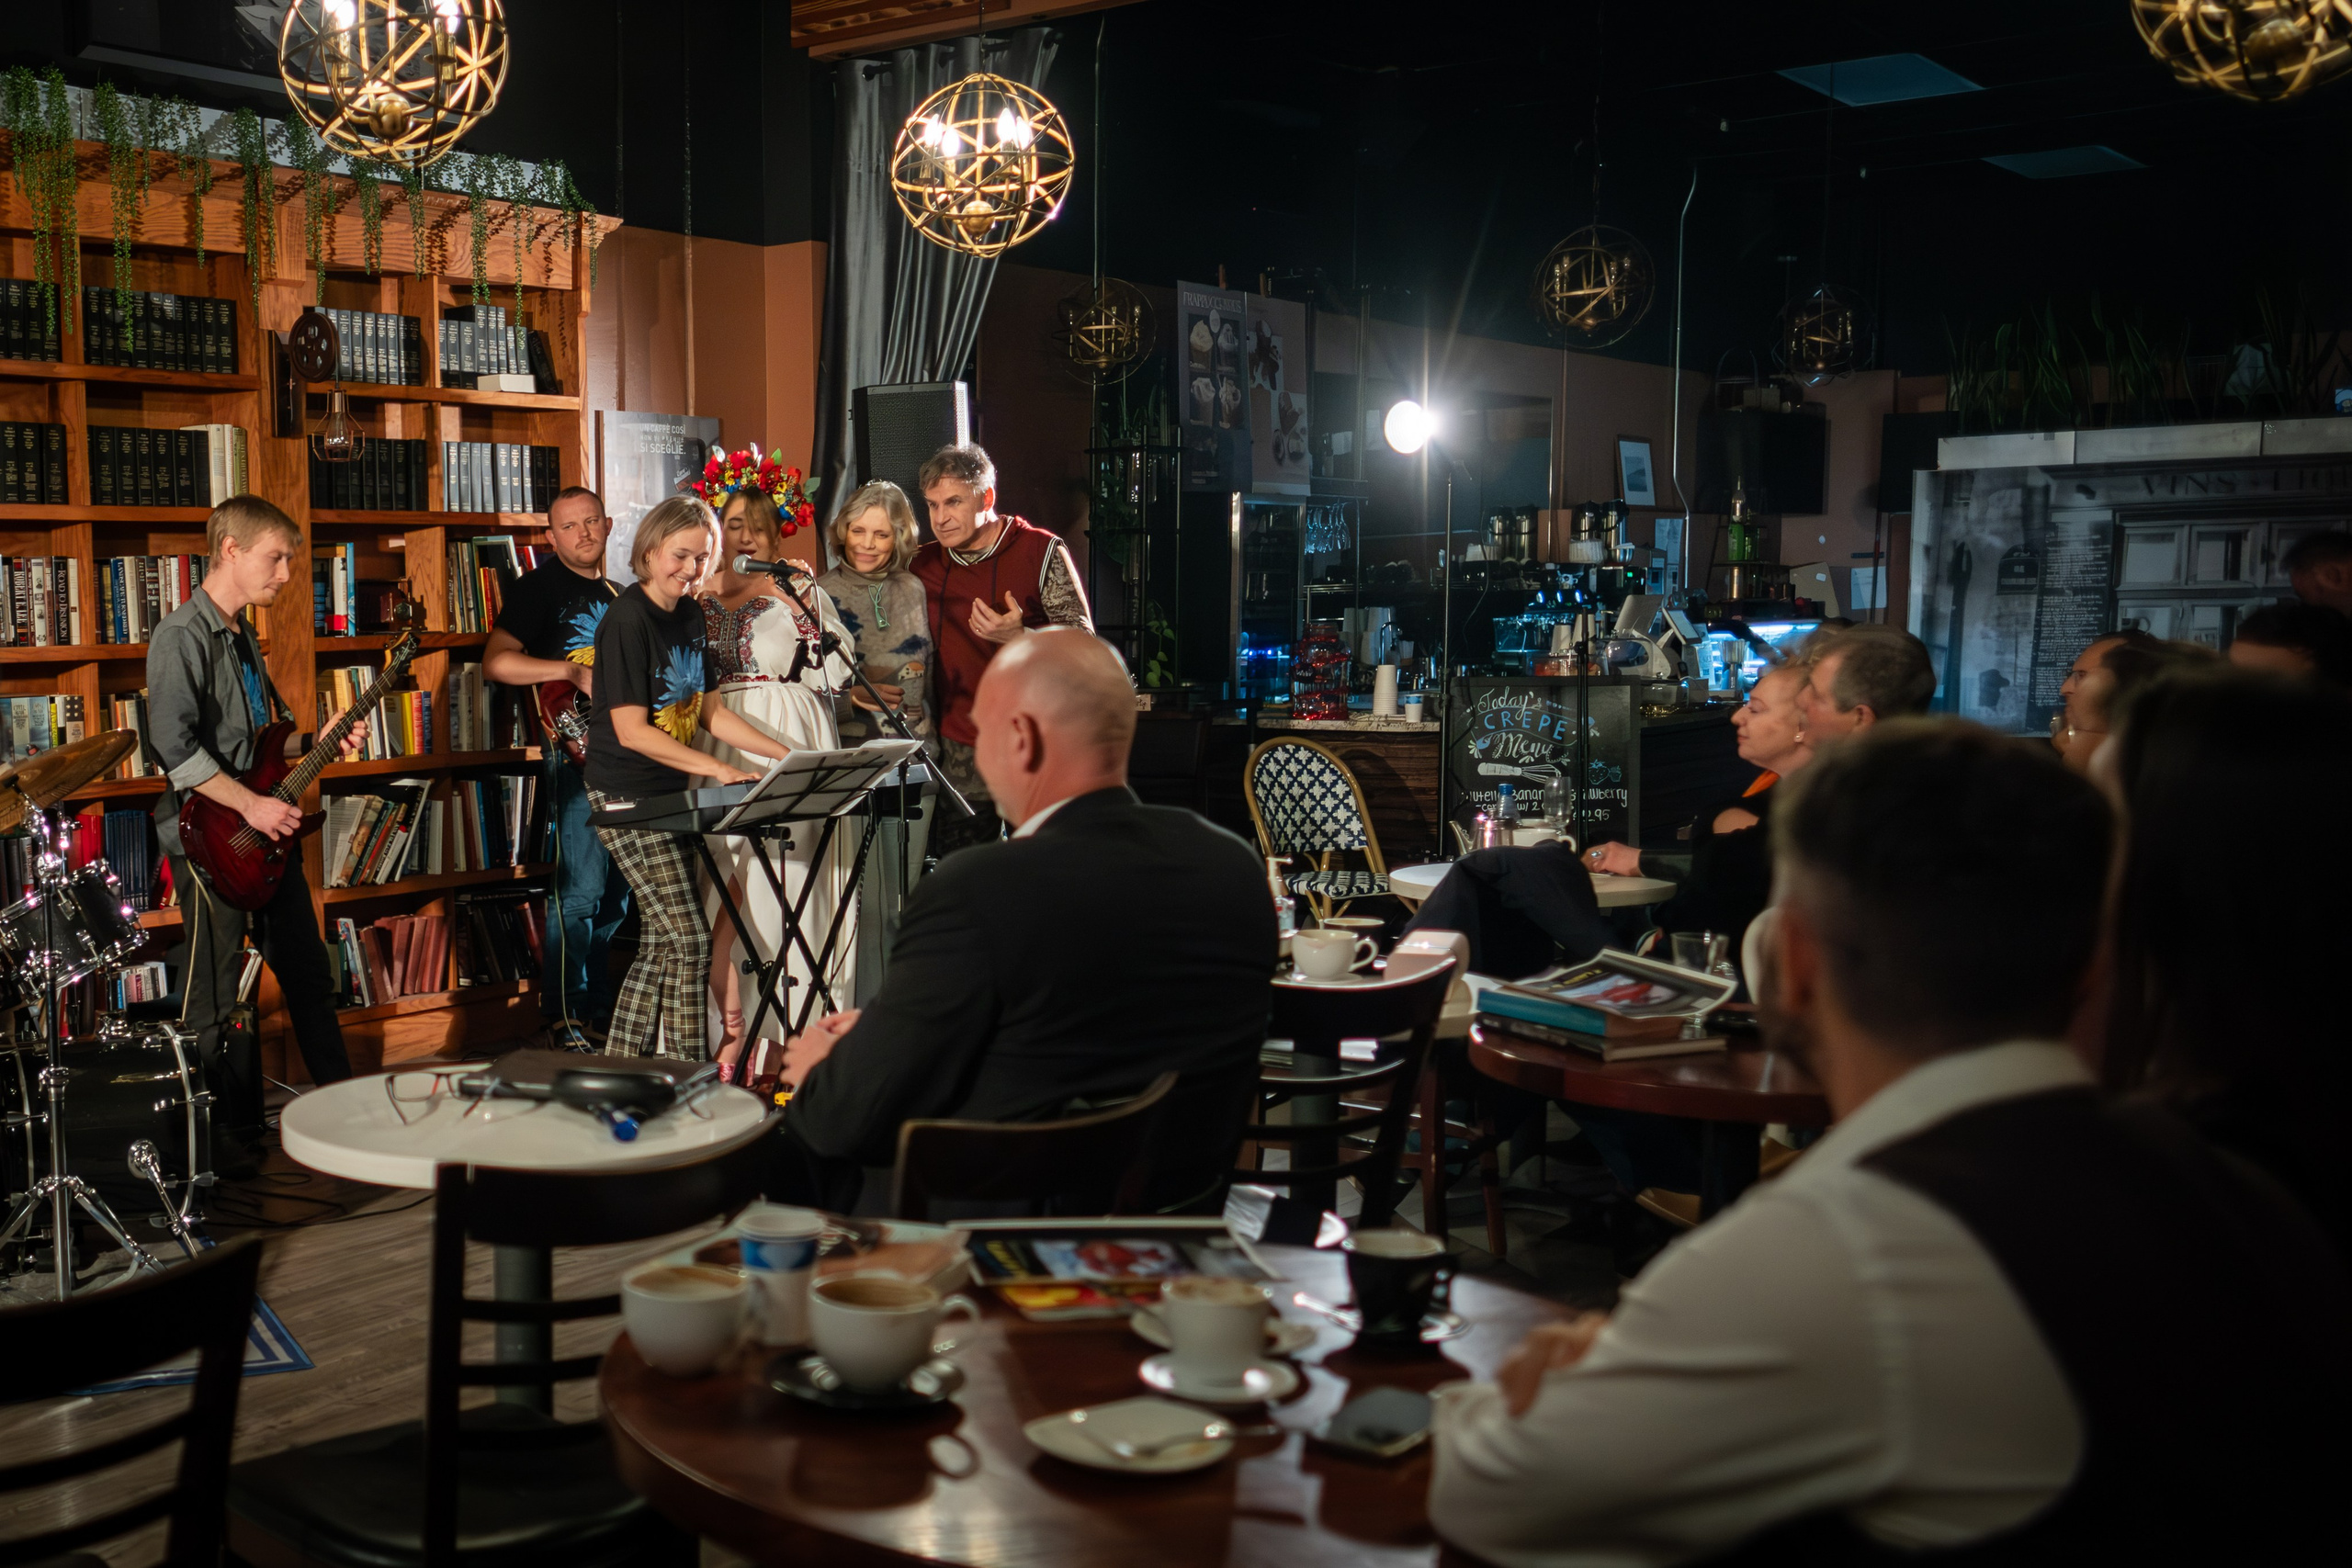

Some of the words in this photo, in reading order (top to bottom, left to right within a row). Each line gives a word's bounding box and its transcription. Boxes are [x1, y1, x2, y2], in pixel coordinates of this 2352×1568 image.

[640, 443, 648, 453] SI
[650, 444, 686, 455] SCEGLIE.
[2141, 472, 2236, 495] VINS
[1477, 686, 1542, 720] Today's
[1484, 711, 1567, 740] CREPE
[1493, 732, 1554, 759] Menu
[1464, 789, 1500, 802] utell
[1511, 789, 1545, 802] Banan
